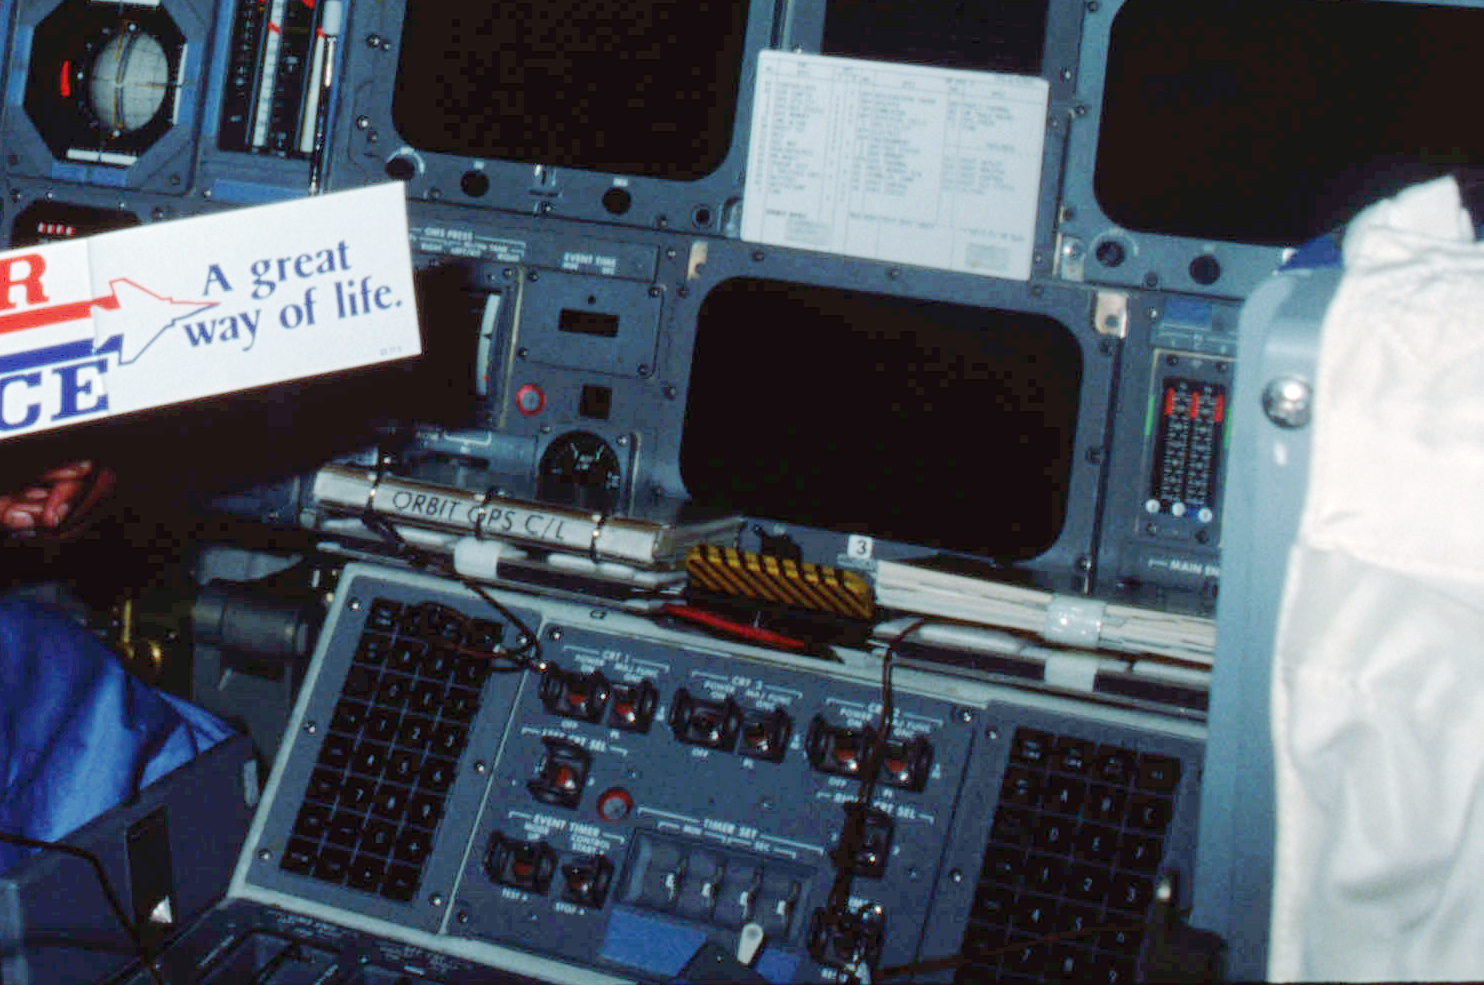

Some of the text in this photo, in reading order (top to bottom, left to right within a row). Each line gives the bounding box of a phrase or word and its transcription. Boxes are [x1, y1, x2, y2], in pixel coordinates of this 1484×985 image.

[202, 263, 233, 297] A
[250, 240, 353, 298] great
[564, 251, 616, 267] EVENT TIME
[183, 276, 404, 352] way of life.
[393, 490, 461, 522] ORBIT
[525, 514, 567, 540] C/L
[857, 539, 867, 555] 3
[1170, 559, 1203, 574] MAIN
[533, 813, 601, 837] EVENT TIMER
[704, 818, 758, 840] TIMER SET
